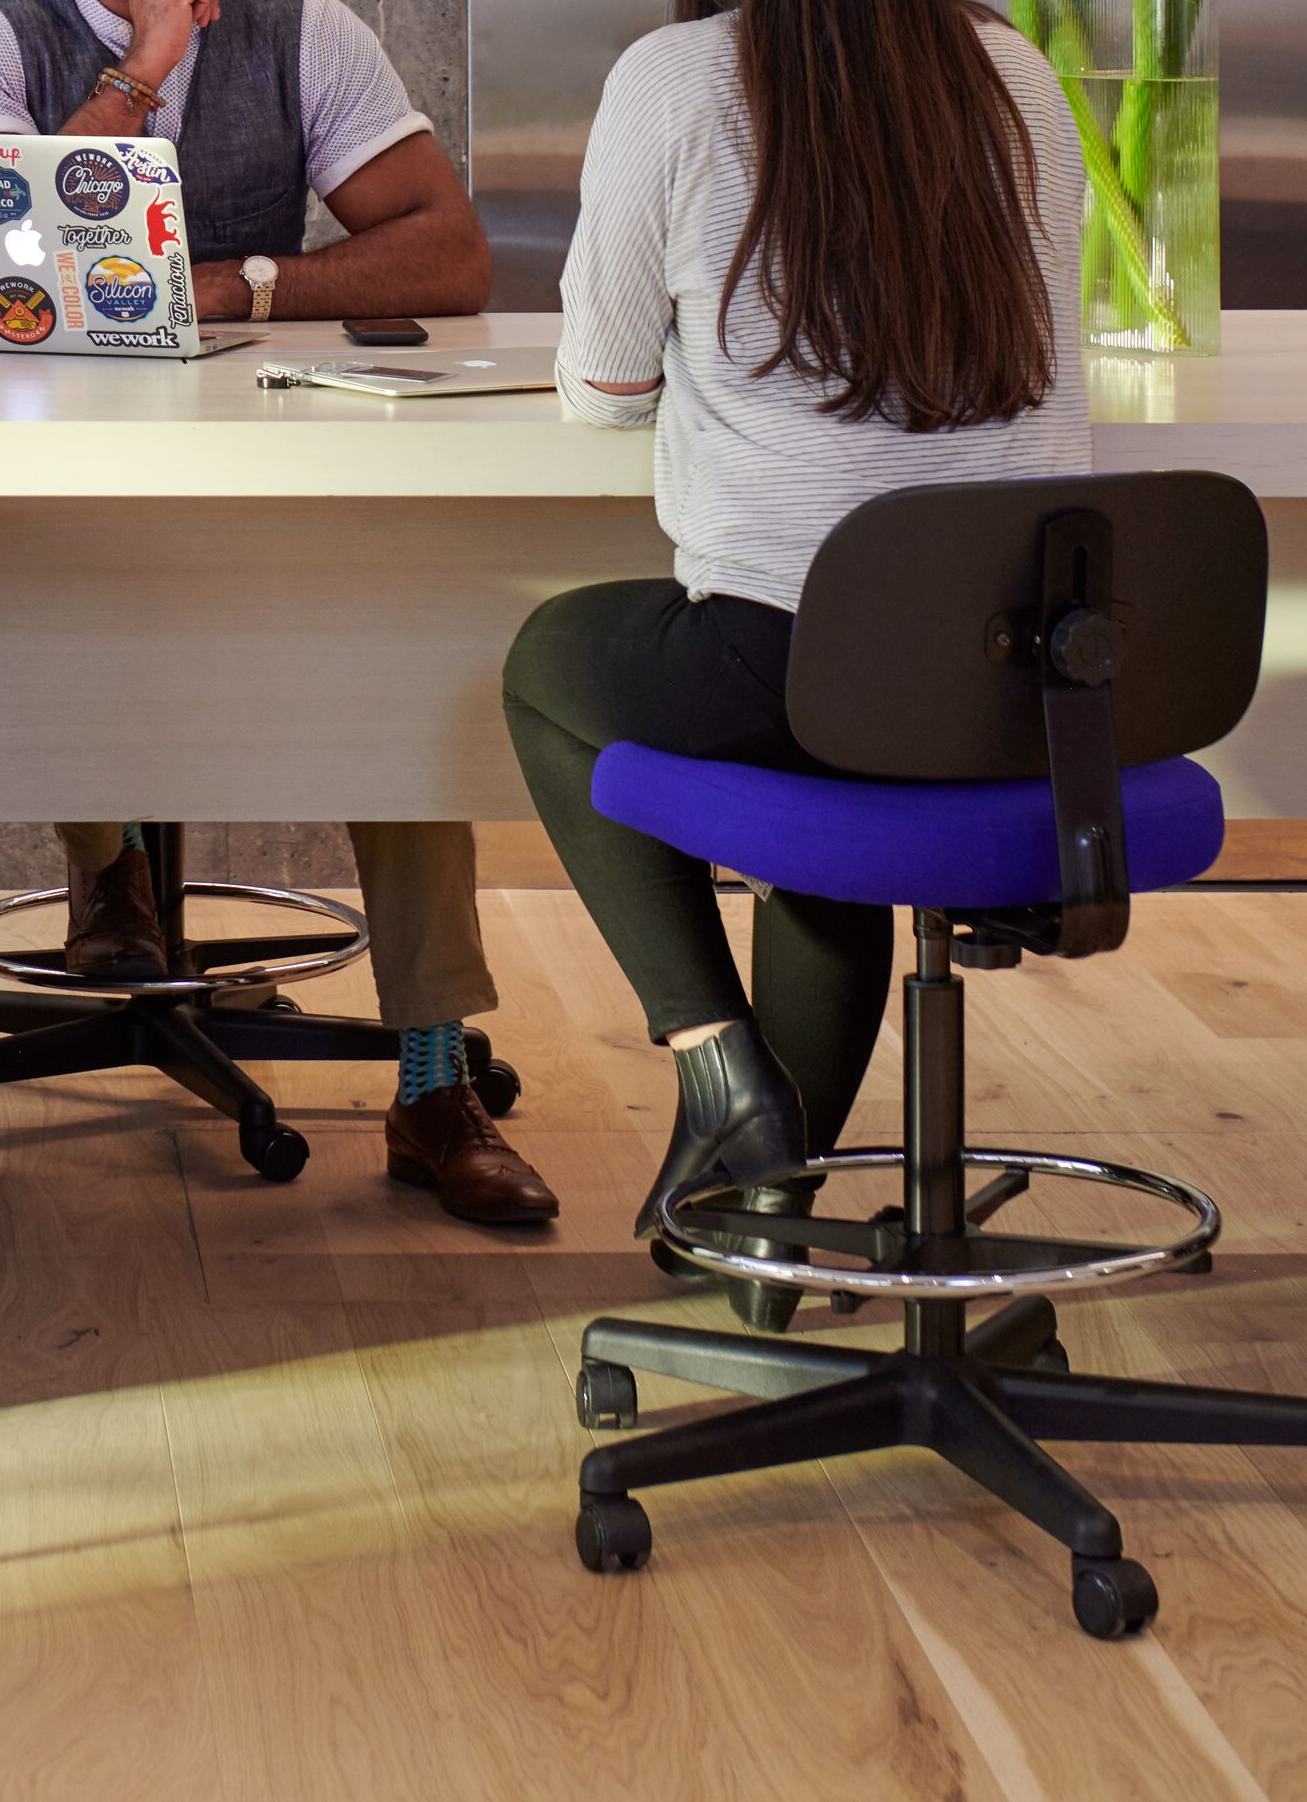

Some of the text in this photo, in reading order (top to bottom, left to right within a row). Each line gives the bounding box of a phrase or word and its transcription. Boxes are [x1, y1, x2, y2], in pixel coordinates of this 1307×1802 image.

[75, 153, 113, 169] WEWORK
[119, 148, 171, 183] Austin
[62, 165, 123, 203] Chicago
[56, 252, 76, 273] WE
[0, 281, 35, 293] WEWORK
[90, 274, 152, 303] Silicon
[62, 286, 84, 329] COLOR
[0, 325, 46, 340] AMSTERDAM
[90, 327, 177, 348] wework
